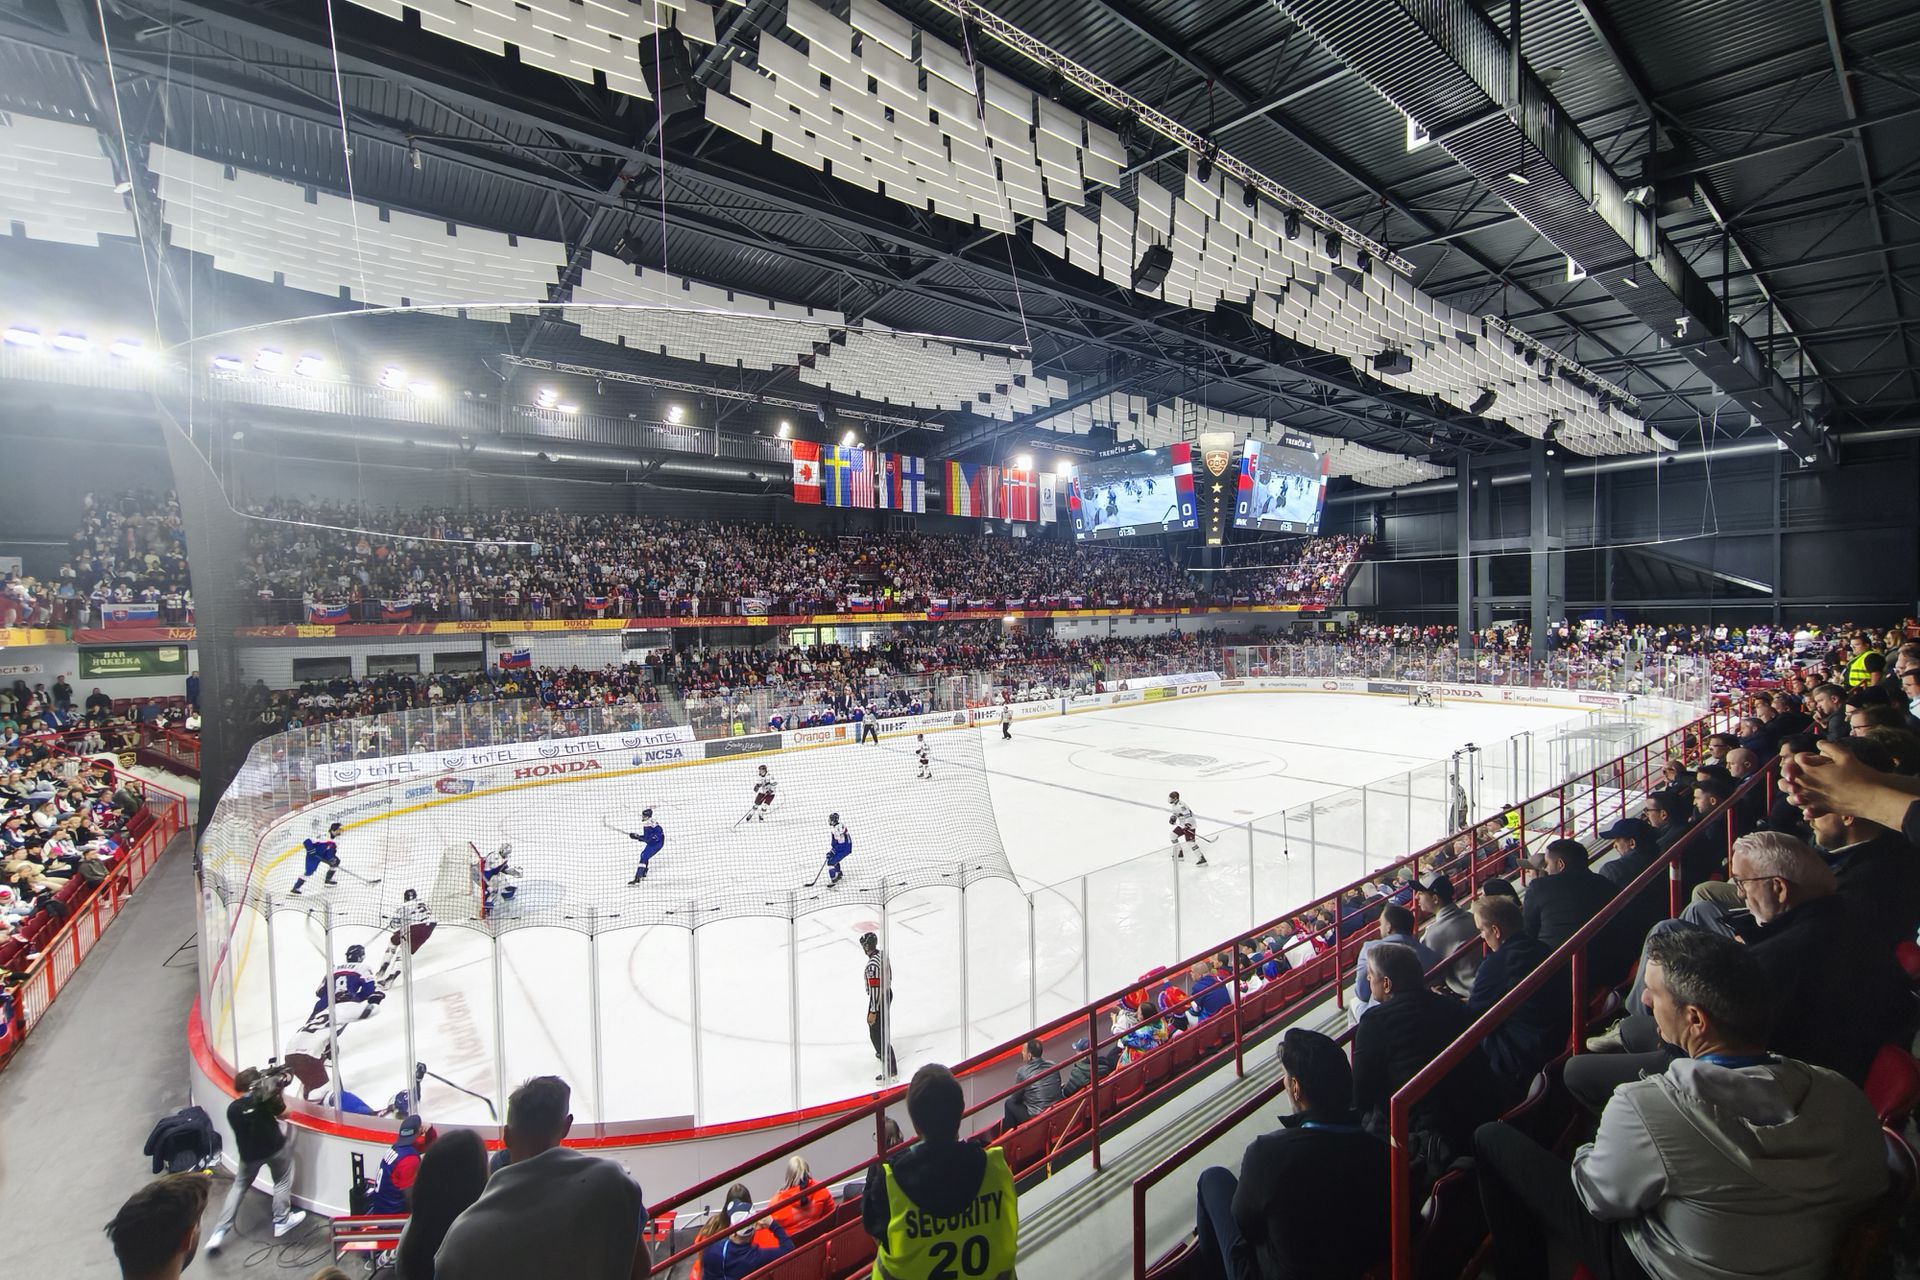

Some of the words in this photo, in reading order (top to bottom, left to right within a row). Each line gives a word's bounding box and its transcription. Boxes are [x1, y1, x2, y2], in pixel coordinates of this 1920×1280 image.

[1099, 446, 1126, 457] TRENČÍN
[1182, 504, 1191, 516] 0
[1240, 502, 1247, 514] 0
[1076, 519, 1082, 529] 0
[563, 619, 594, 628] DUKLA
[92, 658, 141, 666] HOKEJKA
[1181, 684, 1208, 694] CCM
[1516, 695, 1549, 703] Kaufland
[645, 732, 683, 745] tnTEL
[794, 730, 831, 744] Orange
[564, 740, 606, 754] tnTEL
[472, 750, 517, 765] tnTEL
[645, 747, 683, 762] NCSA
[369, 761, 420, 777] tnTEL
[513, 758, 602, 780] HONDA
[905, 1190, 1003, 1240] SECURITY
[928, 1234, 990, 1280] 20
